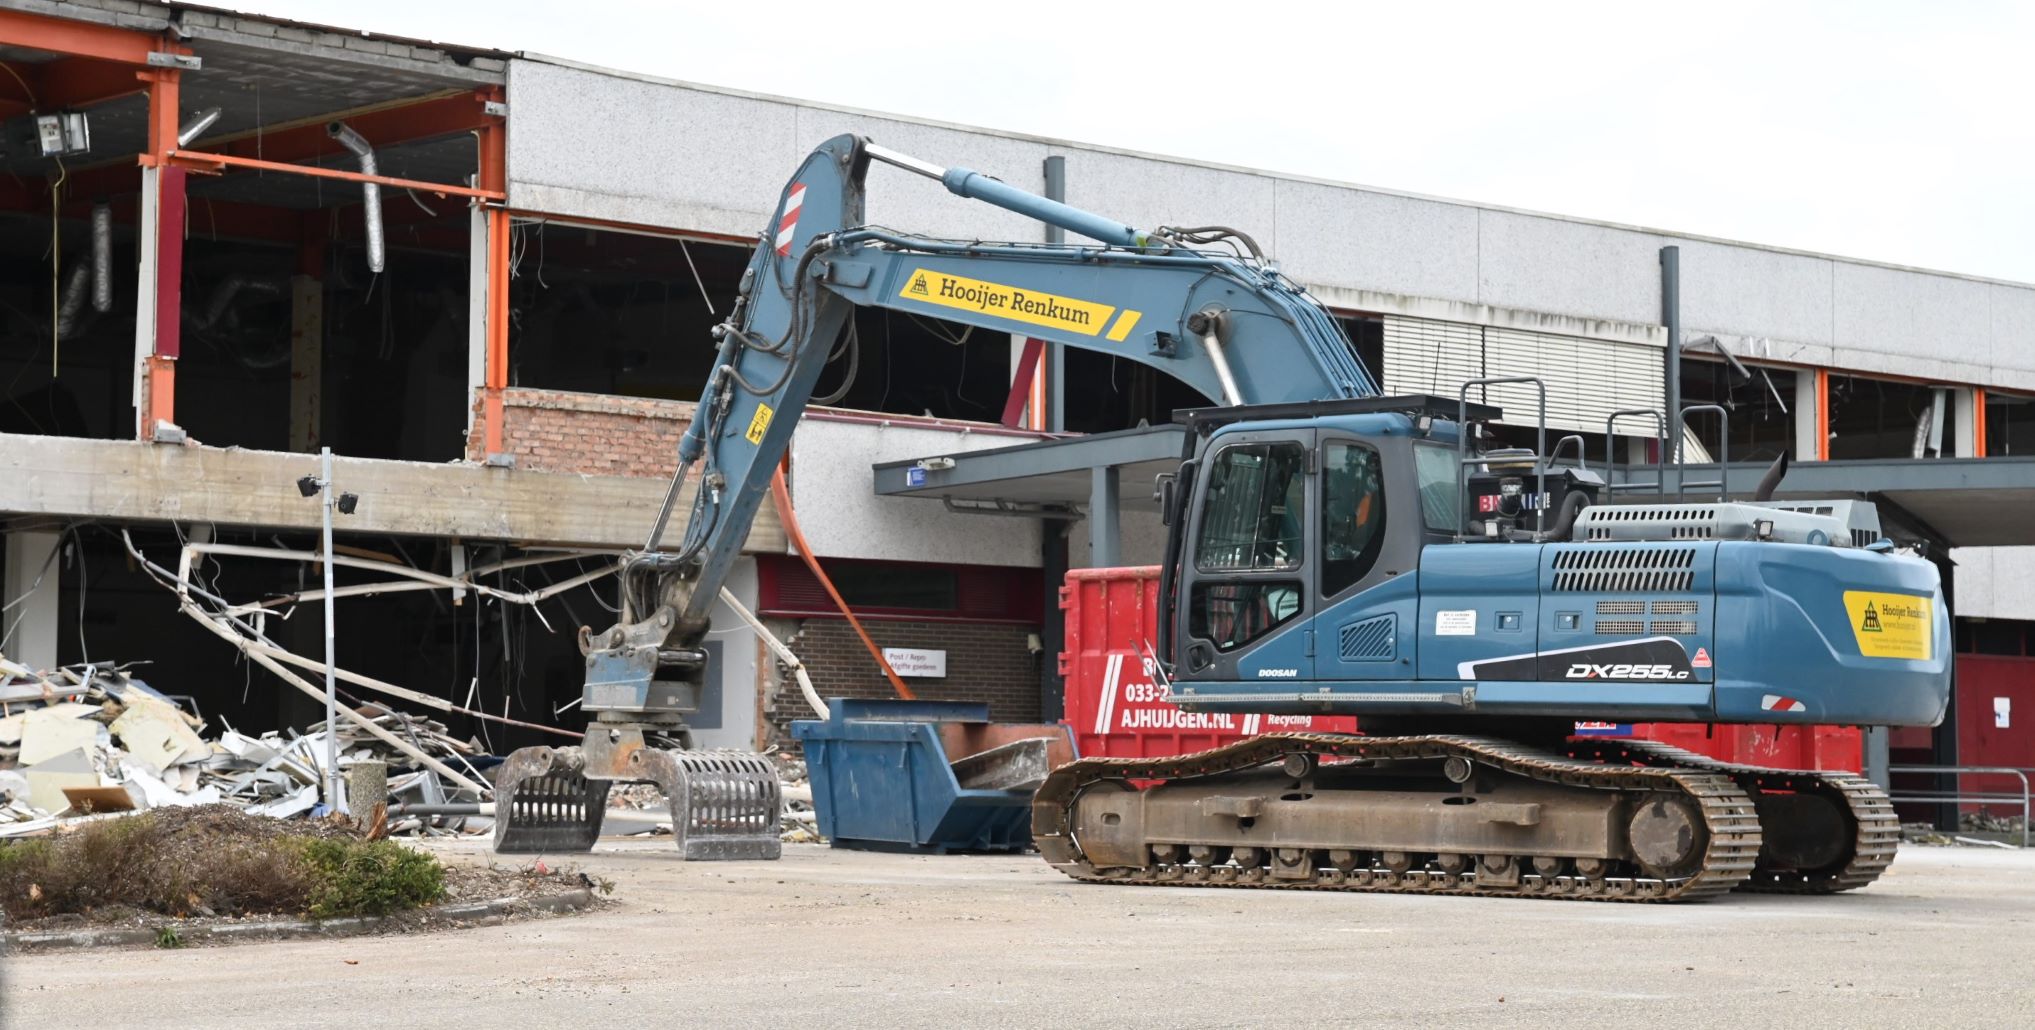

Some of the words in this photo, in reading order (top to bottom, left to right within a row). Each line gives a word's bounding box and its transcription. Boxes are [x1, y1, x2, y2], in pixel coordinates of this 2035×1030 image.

[939, 278, 1008, 310] Hooijer
[1010, 291, 1090, 325] Renkum
[1882, 603, 1906, 620] Hooijer
[889, 653, 904, 661] Post
[1258, 668, 1298, 677] DOOSAN
[1125, 683, 1170, 702] 033-2
[1121, 708, 1235, 729] AJHUIJGEN.NL
[1267, 713, 1312, 728] Recycling
